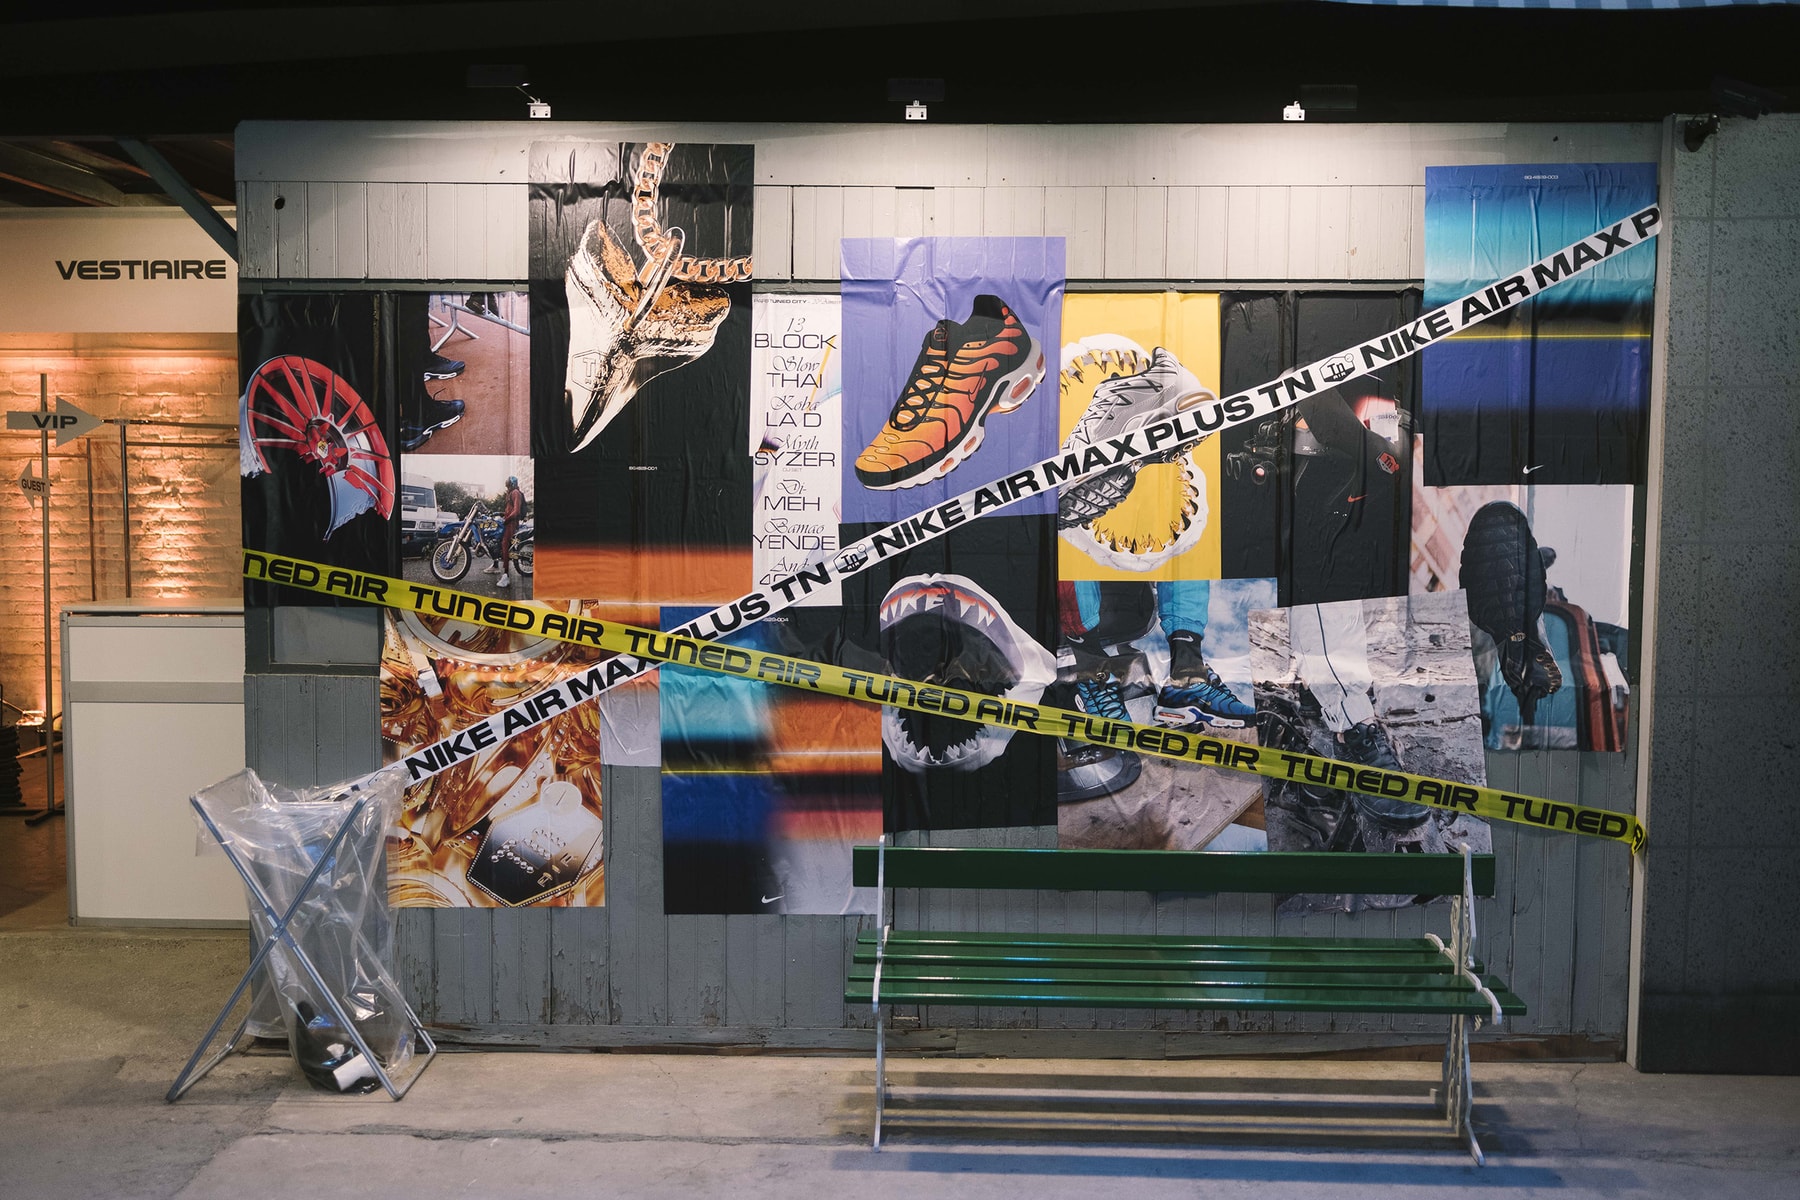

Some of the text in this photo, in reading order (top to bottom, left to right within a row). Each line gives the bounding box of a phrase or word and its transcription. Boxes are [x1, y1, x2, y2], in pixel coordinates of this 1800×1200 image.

[56, 259, 227, 280] VESTIAIRE
[1360, 309, 1454, 369] NIKE
[1461, 275, 1531, 326] AIR
[1531, 222, 1632, 289] MAX
[787, 317, 806, 333] 13
[754, 333, 837, 349] BLOCK
[772, 355, 820, 372] Slow
[766, 373, 823, 388] THAI
[770, 395, 821, 411] Koba
[32, 414, 78, 429] VIP
[771, 434, 819, 451] Myth
[754, 451, 836, 467] SYZER
[871, 369, 1317, 558] NIKE AIR MAX PLUS TN
[21, 478, 46, 492] GUEST
[764, 496, 820, 511] MEH
[764, 517, 825, 534] Bamao
[753, 535, 836, 551] YENDE
[404, 721, 498, 781] NIKE
[503, 688, 568, 738] AIR
[771, 561, 832, 603] TN
[326, 570, 389, 602] AIR
[409, 585, 535, 630] TUNED
[541, 613, 604, 646] AIR
[624, 628, 752, 674] TUNED
[757, 656, 822, 689] AIR
[842, 671, 971, 716] TUNED
[976, 699, 1041, 730] AIR
[1061, 713, 1190, 757] TUNED
[1196, 739, 1261, 771] AIR
[1281, 754, 1410, 798] TUNED
[1415, 780, 1480, 812] AIR
[1501, 794, 1629, 838] TUNED
